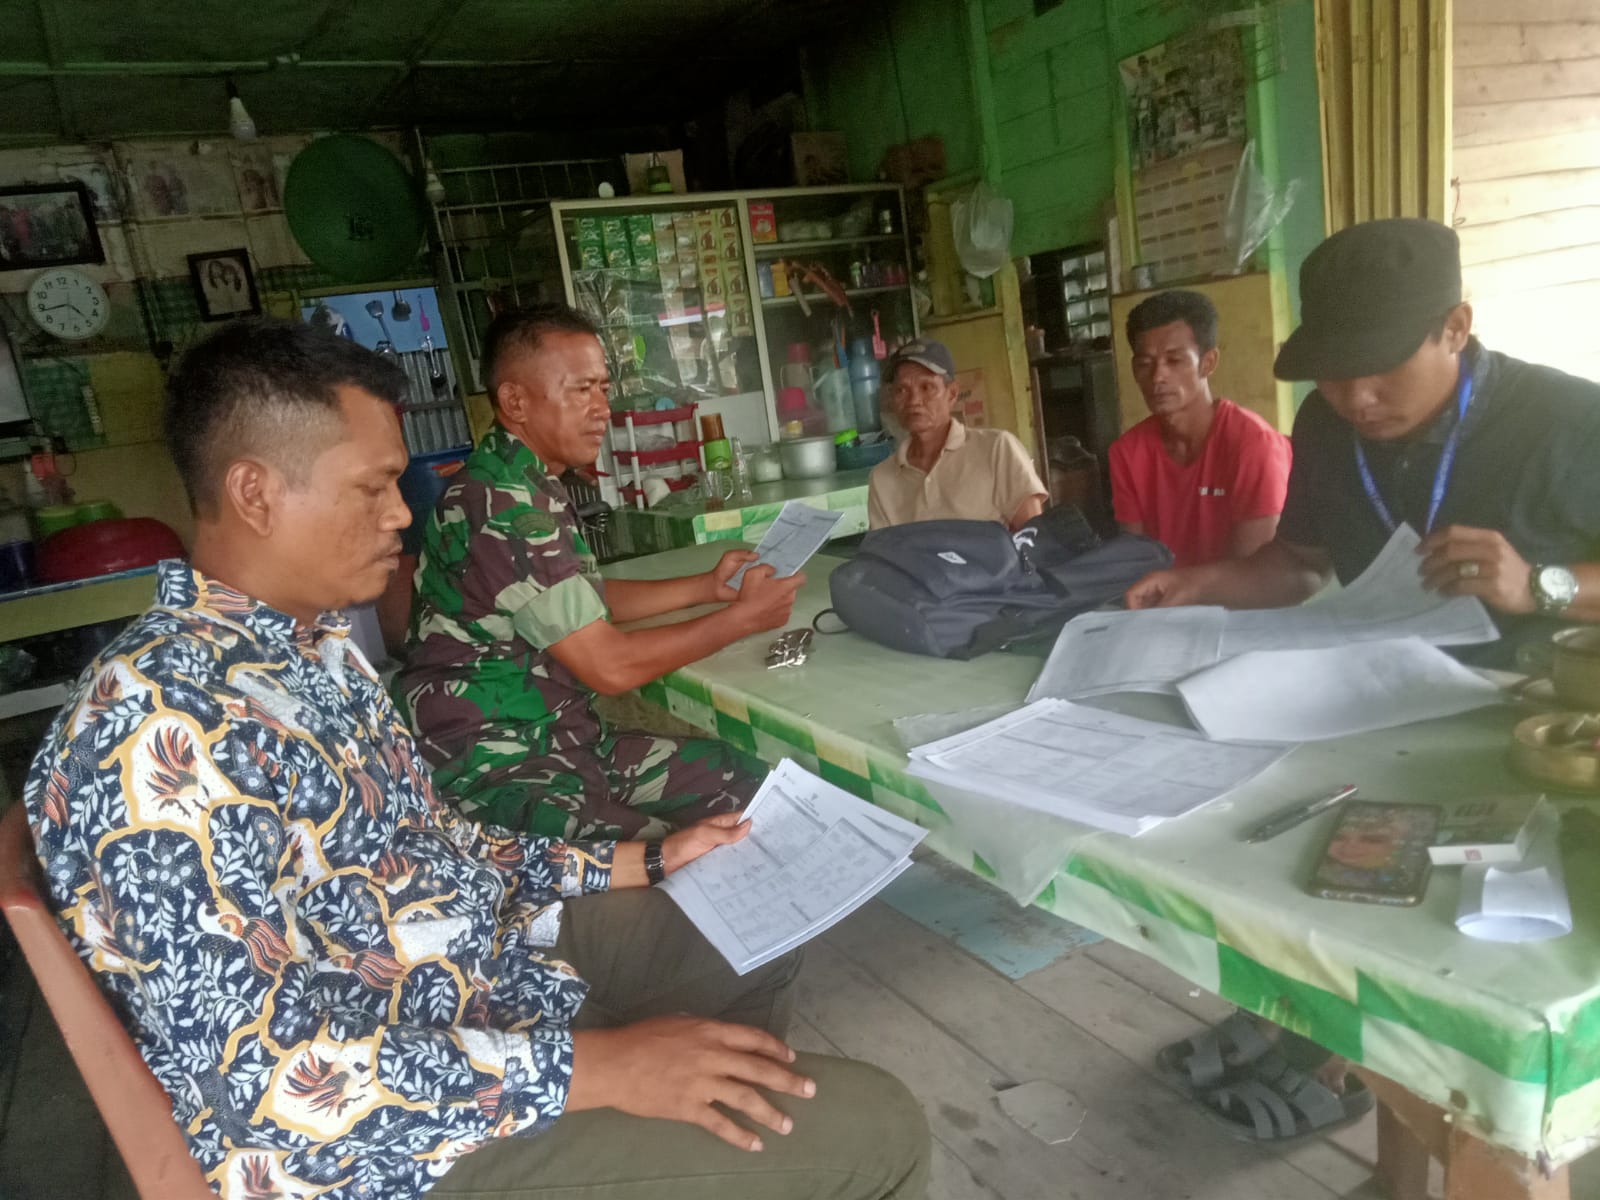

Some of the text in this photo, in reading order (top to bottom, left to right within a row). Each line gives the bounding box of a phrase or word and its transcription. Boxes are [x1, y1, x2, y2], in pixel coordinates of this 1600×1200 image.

[56, 276, 67, 285] 12
[43, 281, 54, 290] 11
[85, 286, 92, 294] 2
[36, 291, 48, 300] 10
[92, 296, 100, 306] 3
[38, 303, 46, 312] 9
[91, 308, 99, 318] 4
[58, 322, 65, 331] 7
